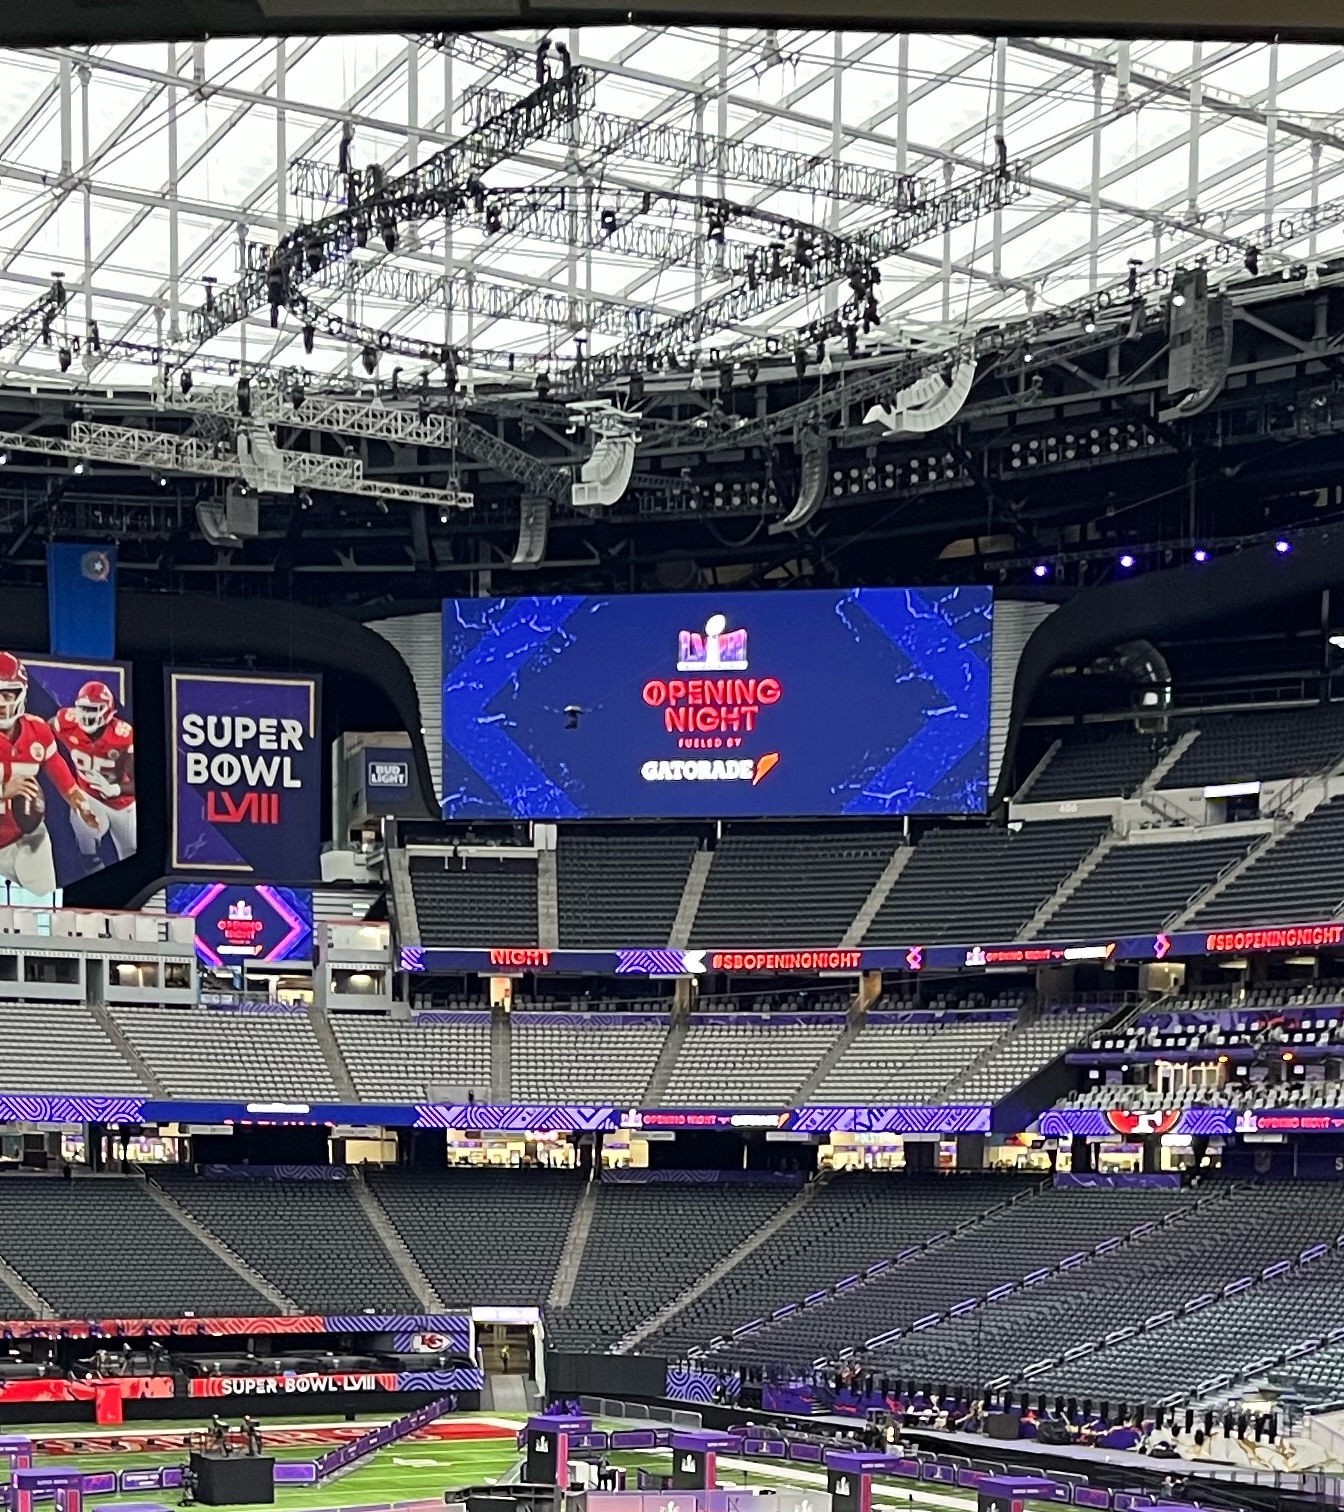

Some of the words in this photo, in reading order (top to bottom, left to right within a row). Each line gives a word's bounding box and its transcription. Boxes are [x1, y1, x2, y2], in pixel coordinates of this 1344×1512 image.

[642, 678, 782, 707] OPENING
[664, 706, 758, 732] NIGHT
[182, 713, 304, 752] SUPER
[186, 753, 302, 789] BOWL
[640, 759, 754, 781] GATORADE
[206, 791, 279, 825] LVIII
[1206, 925, 1344, 952] #SBOPENINGNIGHT
[489, 948, 552, 967] NIGHT
[712, 951, 862, 971] #SBOPENINGNIGHT
[221, 1377, 278, 1395] SUPER
[285, 1376, 338, 1393] BOWL
[343, 1375, 376, 1391] LVIII
